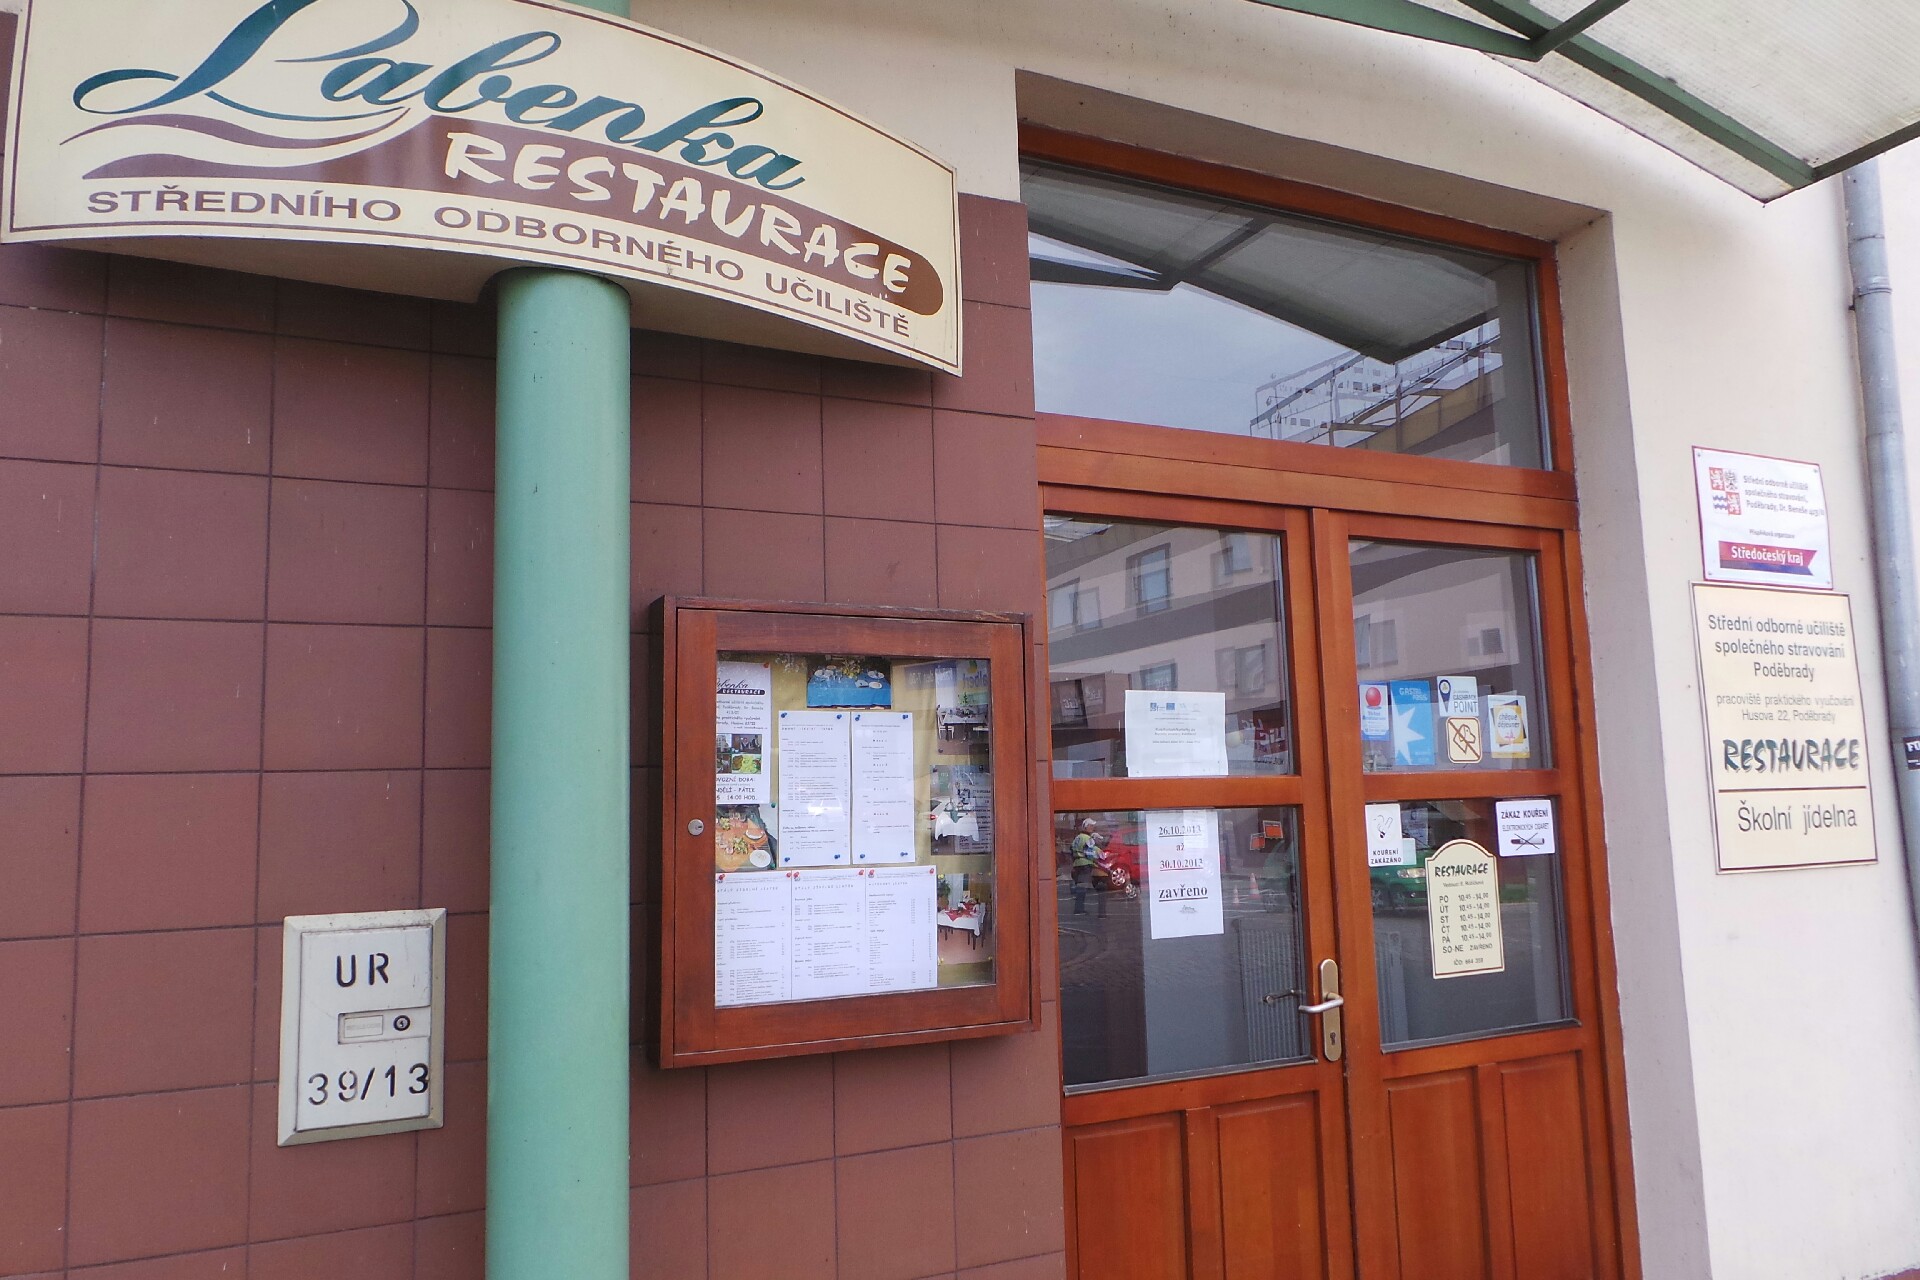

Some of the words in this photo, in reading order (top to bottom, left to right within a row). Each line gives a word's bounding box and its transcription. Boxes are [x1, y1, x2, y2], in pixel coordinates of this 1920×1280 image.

[72, 0, 805, 191] Labenka
[444, 132, 913, 296] RESTAURACE
[87, 184, 402, 223] STŘEDNÍHO
[434, 206, 745, 282] ODBORNÉHO
[765, 272, 911, 339] UČILIŠTĚ
[1731, 545, 1786, 564] Středočeský
[1787, 550, 1804, 566] kraj
[1708, 614, 1753, 632] Střední
[1756, 618, 1804, 635] odborné
[1806, 620, 1846, 637] učiliště
[1714, 638, 1784, 657] společného
[1788, 643, 1846, 658] stravování
[1753, 662, 1815, 682] Poděbrady
[1454, 701, 1478, 713] POINT
[1716, 692, 1761, 709] pracoviště
[1764, 693, 1812, 708] praktického
[1742, 709, 1774, 721] Husova
[1792, 709, 1836, 724] Poděbrady
[1722, 738, 1861, 774] RESTAURACE
[1500, 808, 1520, 820] ZÁKAZ
[1522, 808, 1549, 818] KOUŘENÍ
[1737, 800, 1792, 832] Školní
[1802, 804, 1858, 836] jídelna
[1372, 848, 1399, 856] KOUŘENÍ
[1434, 863, 1489, 878] RESTAURACE
[1158, 884, 1208, 899] zavřeno
[1439, 895, 1448, 904] PO
[1440, 916, 1449, 924] ST
[336, 952, 390, 988] UR
[308, 1062, 430, 1106] 39/13
